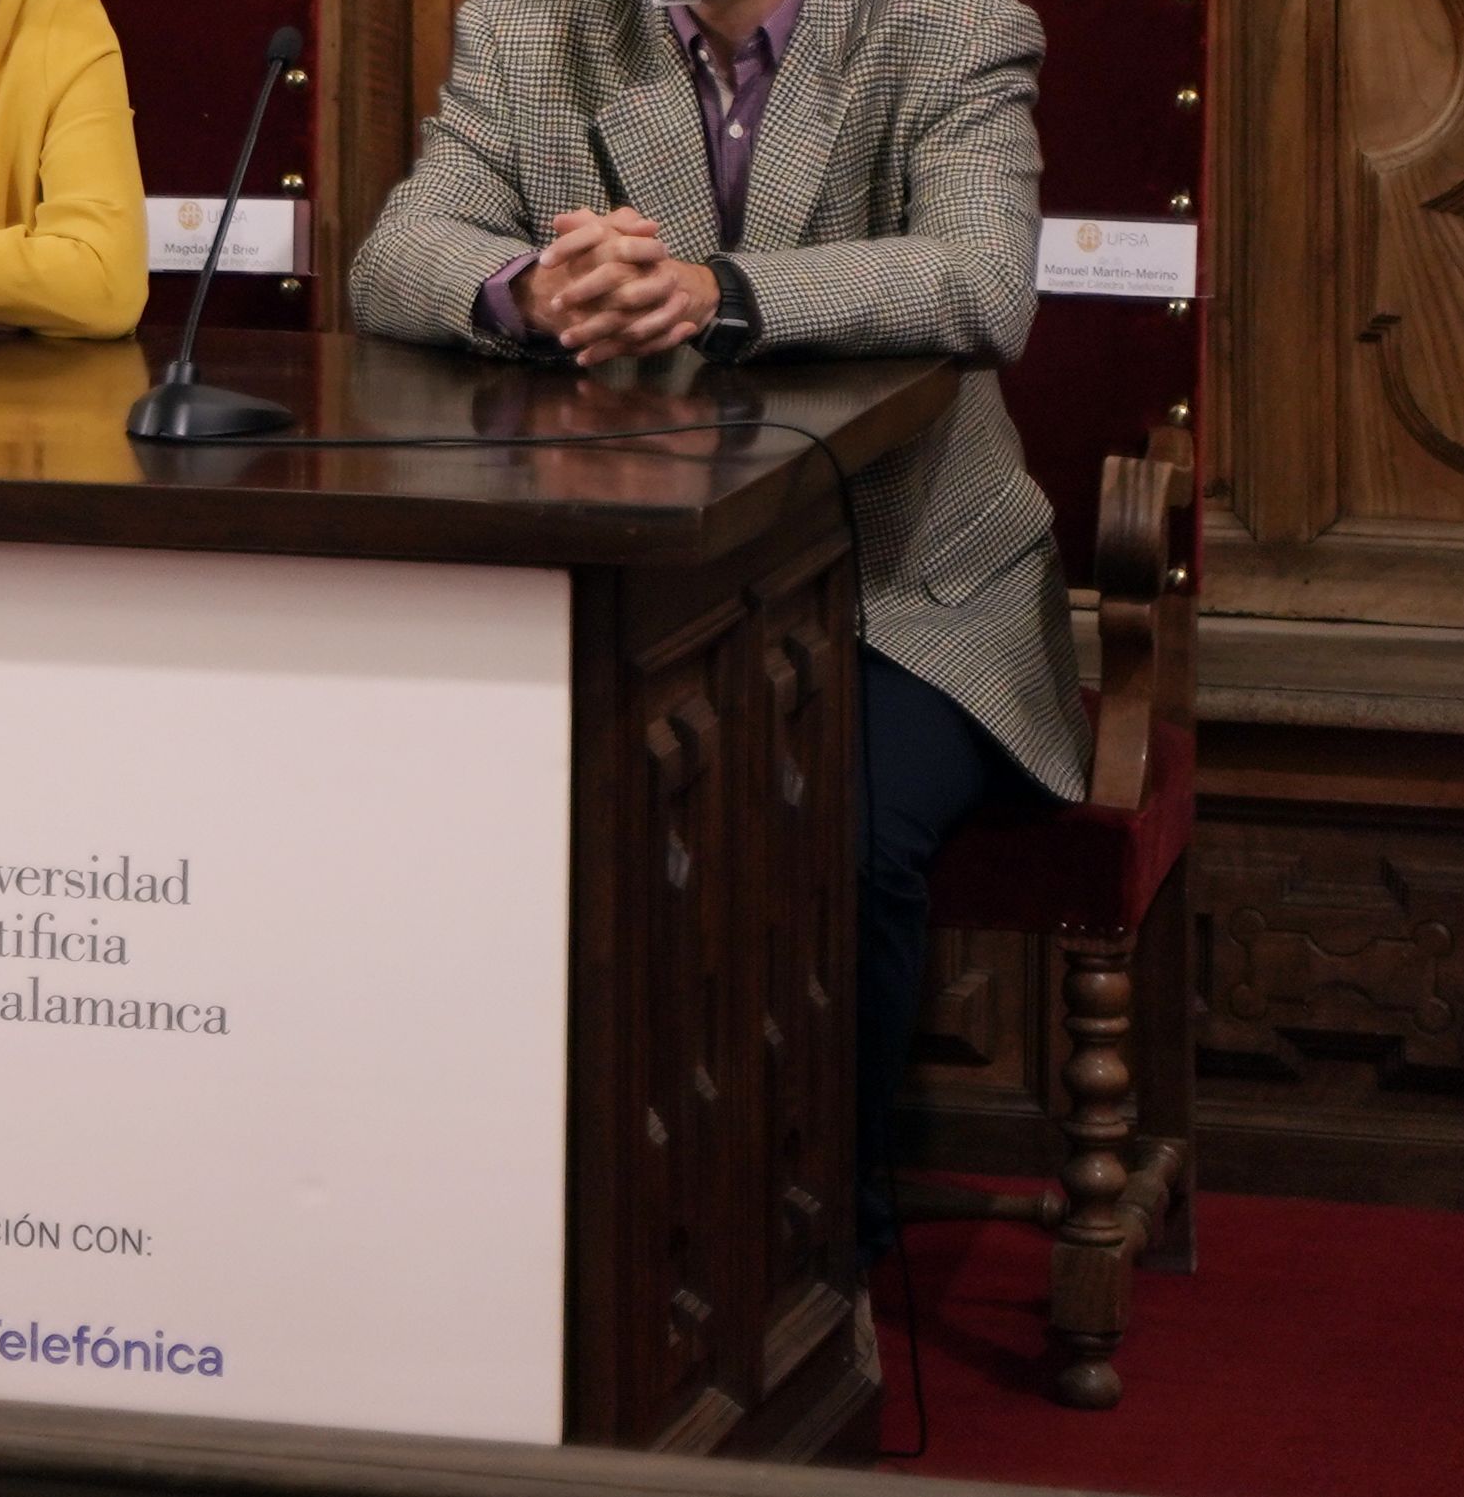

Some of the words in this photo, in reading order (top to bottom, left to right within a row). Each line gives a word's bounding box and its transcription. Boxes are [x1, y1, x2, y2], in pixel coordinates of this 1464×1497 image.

[207, 209, 248, 224] USA
[1107, 232, 1150, 247] UPSA
[1044, 264, 1089, 276] Manuel
[72, 1223, 154, 1258] CON:
